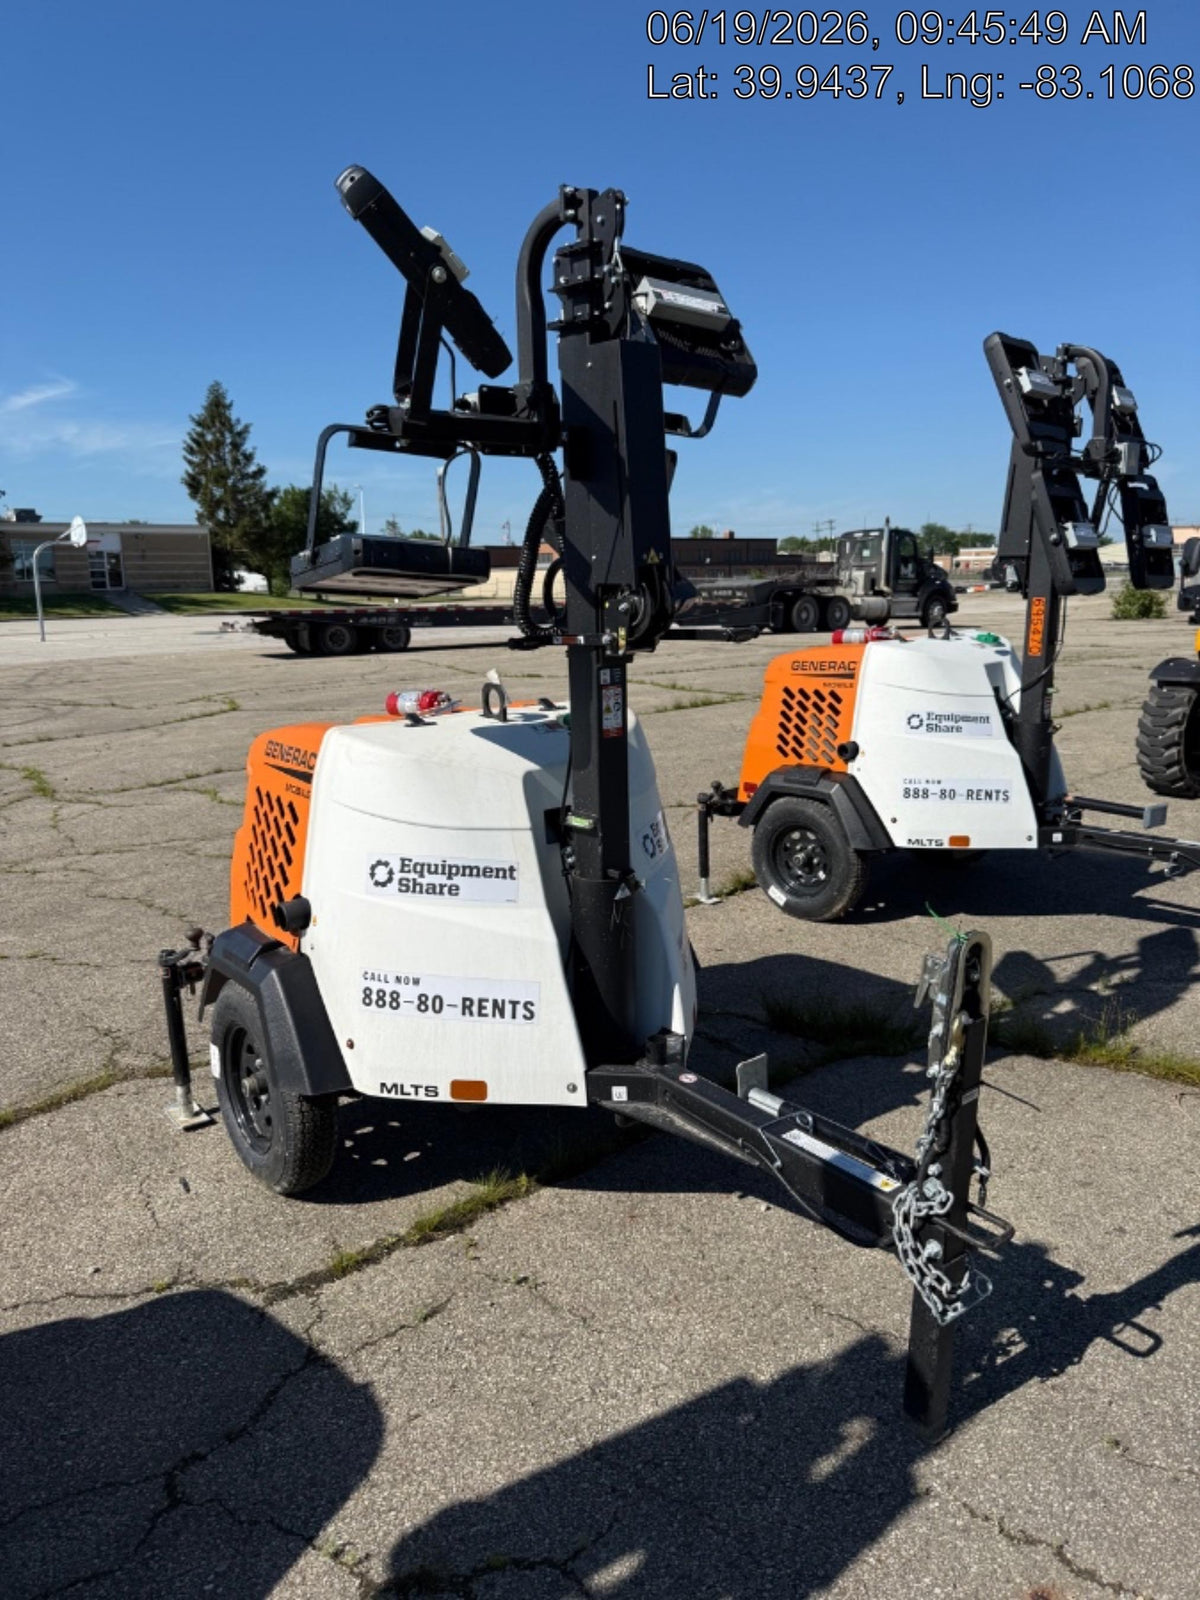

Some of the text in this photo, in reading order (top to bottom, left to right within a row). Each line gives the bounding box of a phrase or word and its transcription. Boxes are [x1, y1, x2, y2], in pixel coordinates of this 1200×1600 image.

[791, 660, 857, 671] GENERAC
[926, 711, 991, 724] Equipment
[925, 722, 963, 733] Share
[264, 740, 318, 770] GENERAC
[903, 787, 1010, 802] 888-80-RENTS
[907, 838, 944, 847] MLTS
[399, 857, 516, 881] Equipment
[398, 877, 460, 896] Share
[362, 971, 421, 986] CALL NOW
[362, 986, 536, 1021] 888-80-RENTS
[380, 1082, 439, 1097] MLTS
